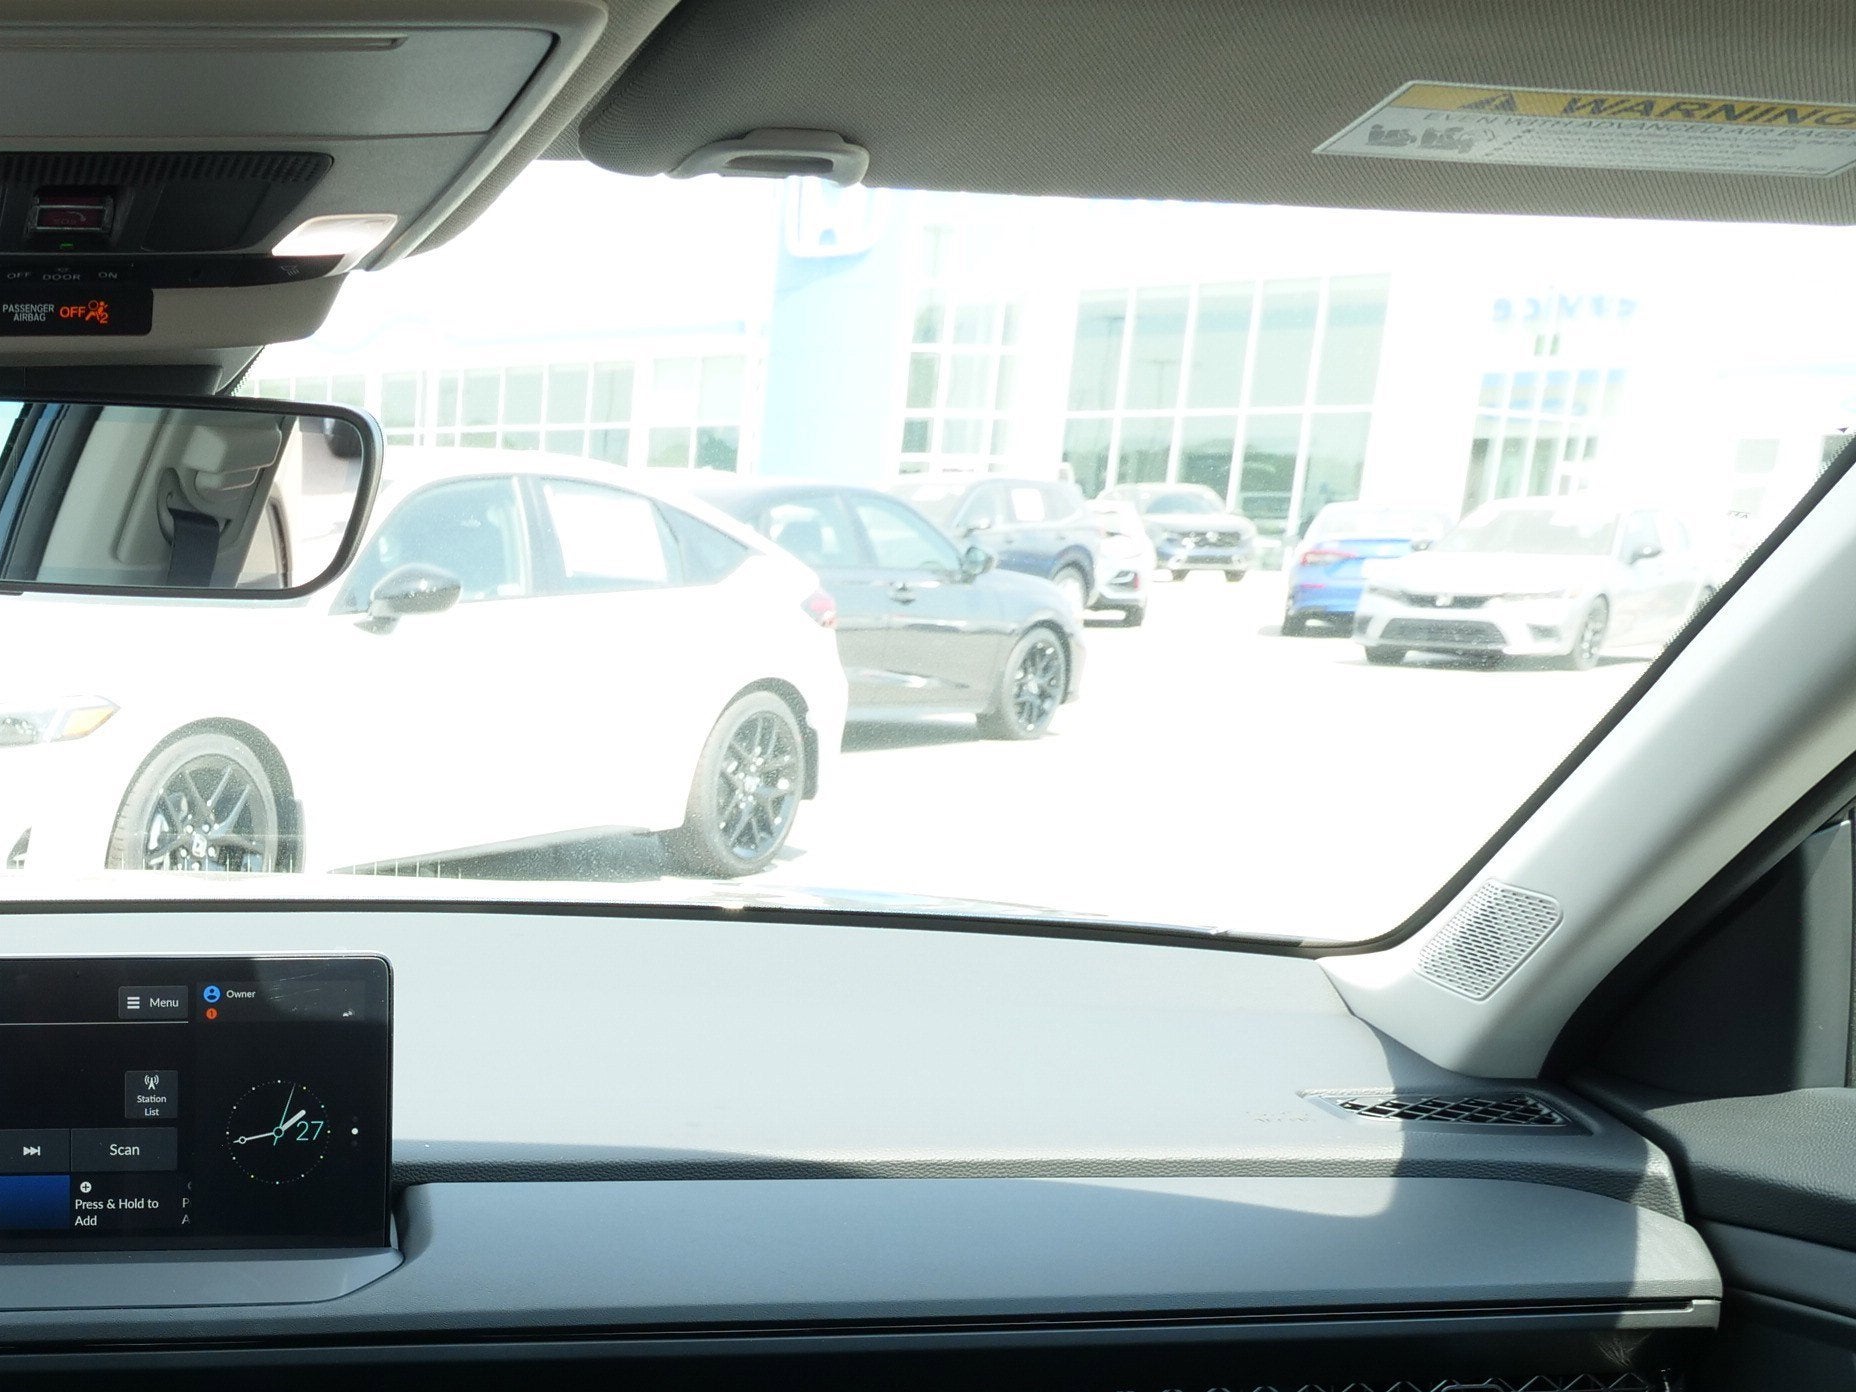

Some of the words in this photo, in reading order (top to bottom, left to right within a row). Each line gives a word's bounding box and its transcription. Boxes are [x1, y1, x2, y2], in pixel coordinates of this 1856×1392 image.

[1560, 97, 1856, 127] WARNING
[3, 304, 54, 313] PASSENGER
[60, 307, 86, 318] OFF
[13, 313, 46, 322] AIRBAG
[226, 990, 256, 999] Owner
[149, 997, 179, 1008] Menu
[137, 1095, 167, 1104] Station
[144, 1108, 159, 1116] List
[296, 1121, 324, 1141] 27
[109, 1144, 140, 1157] Scan
[75, 1199, 104, 1209] Press
[107, 1199, 116, 1209] &
[119, 1198, 145, 1209] Hold
[147, 1199, 159, 1208] to
[75, 1215, 97, 1226] Add
